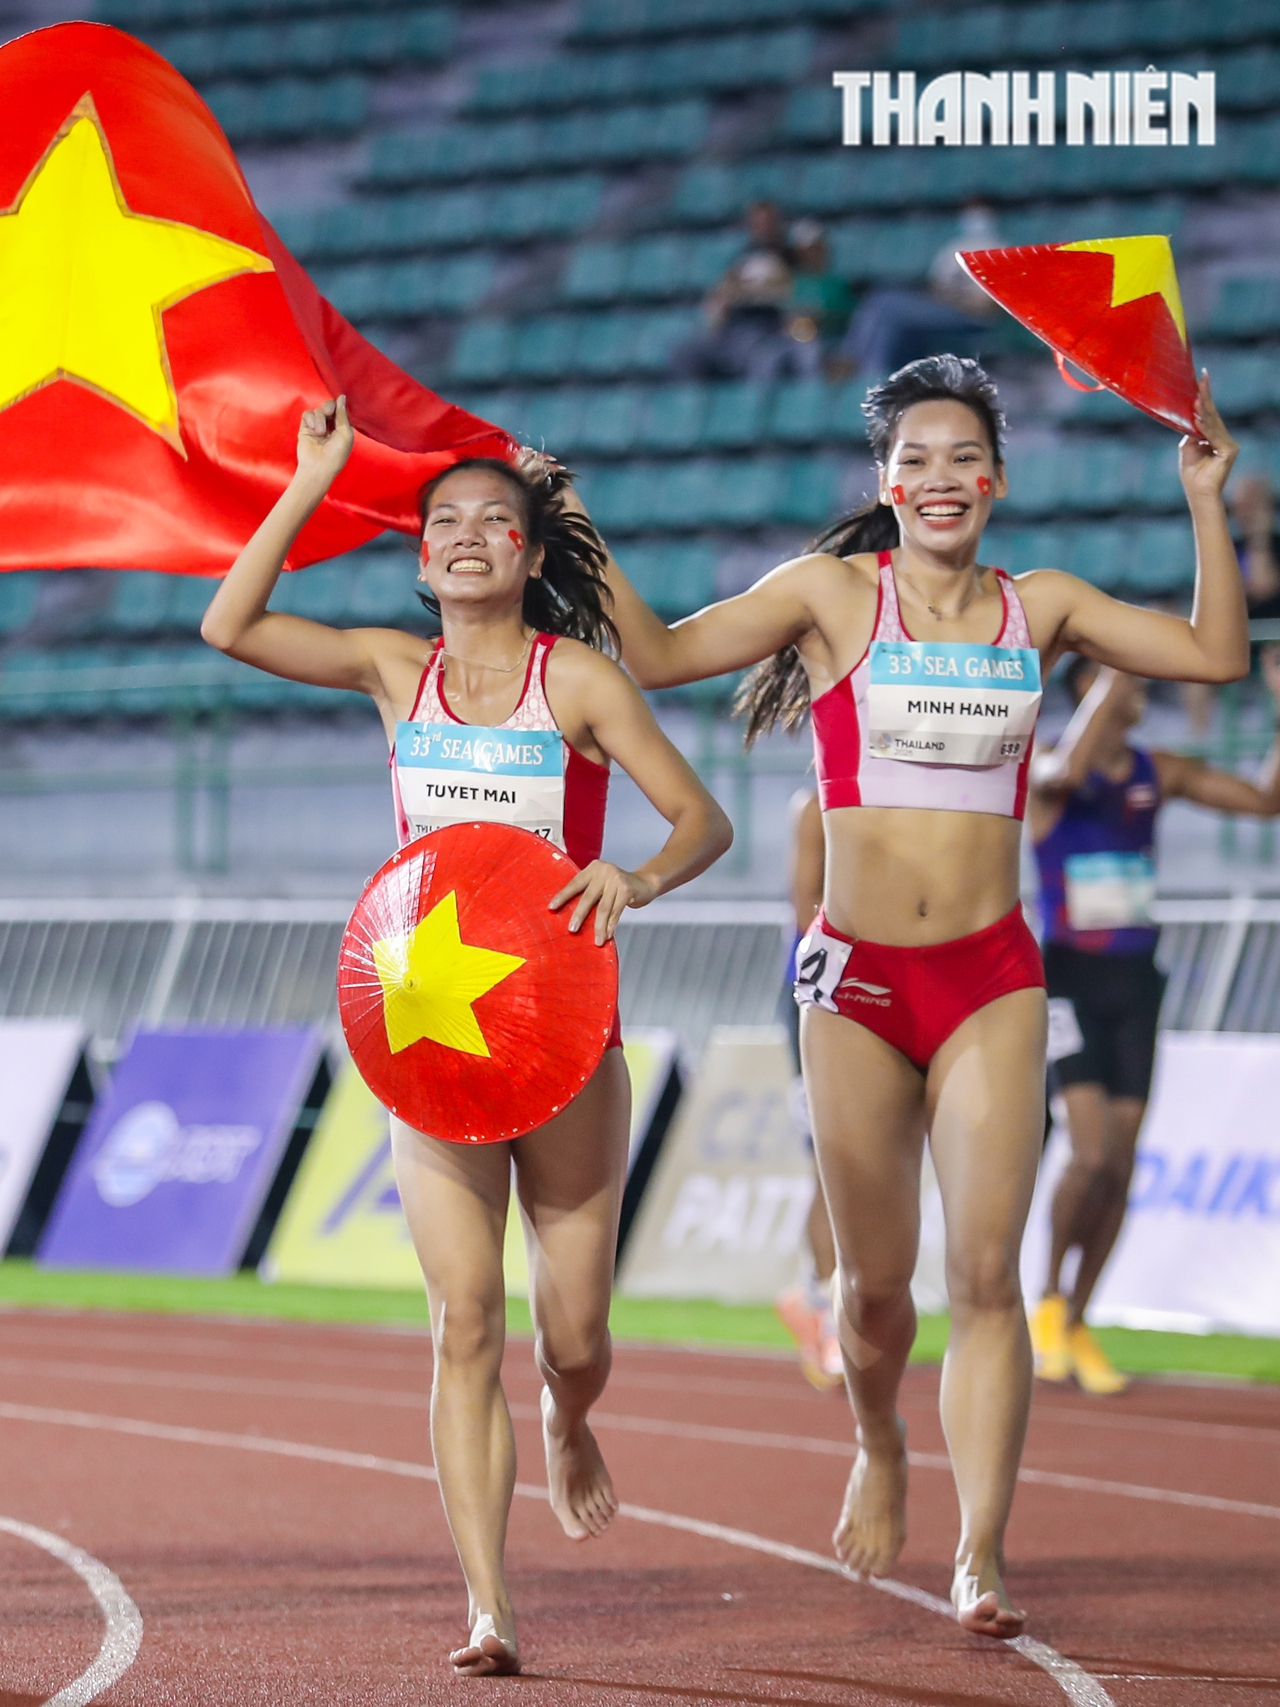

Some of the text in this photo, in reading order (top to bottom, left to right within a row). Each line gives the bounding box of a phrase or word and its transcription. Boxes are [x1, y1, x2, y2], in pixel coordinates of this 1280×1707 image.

[924, 655, 959, 676] SEA
[965, 656, 1024, 680] GAMES
[907, 700, 1009, 717] MINH HANH
[439, 737, 472, 760] SEA
[479, 741, 543, 765] GAMES
[895, 738, 946, 751] THAILAND
[426, 784, 517, 804] TUYET MAI
